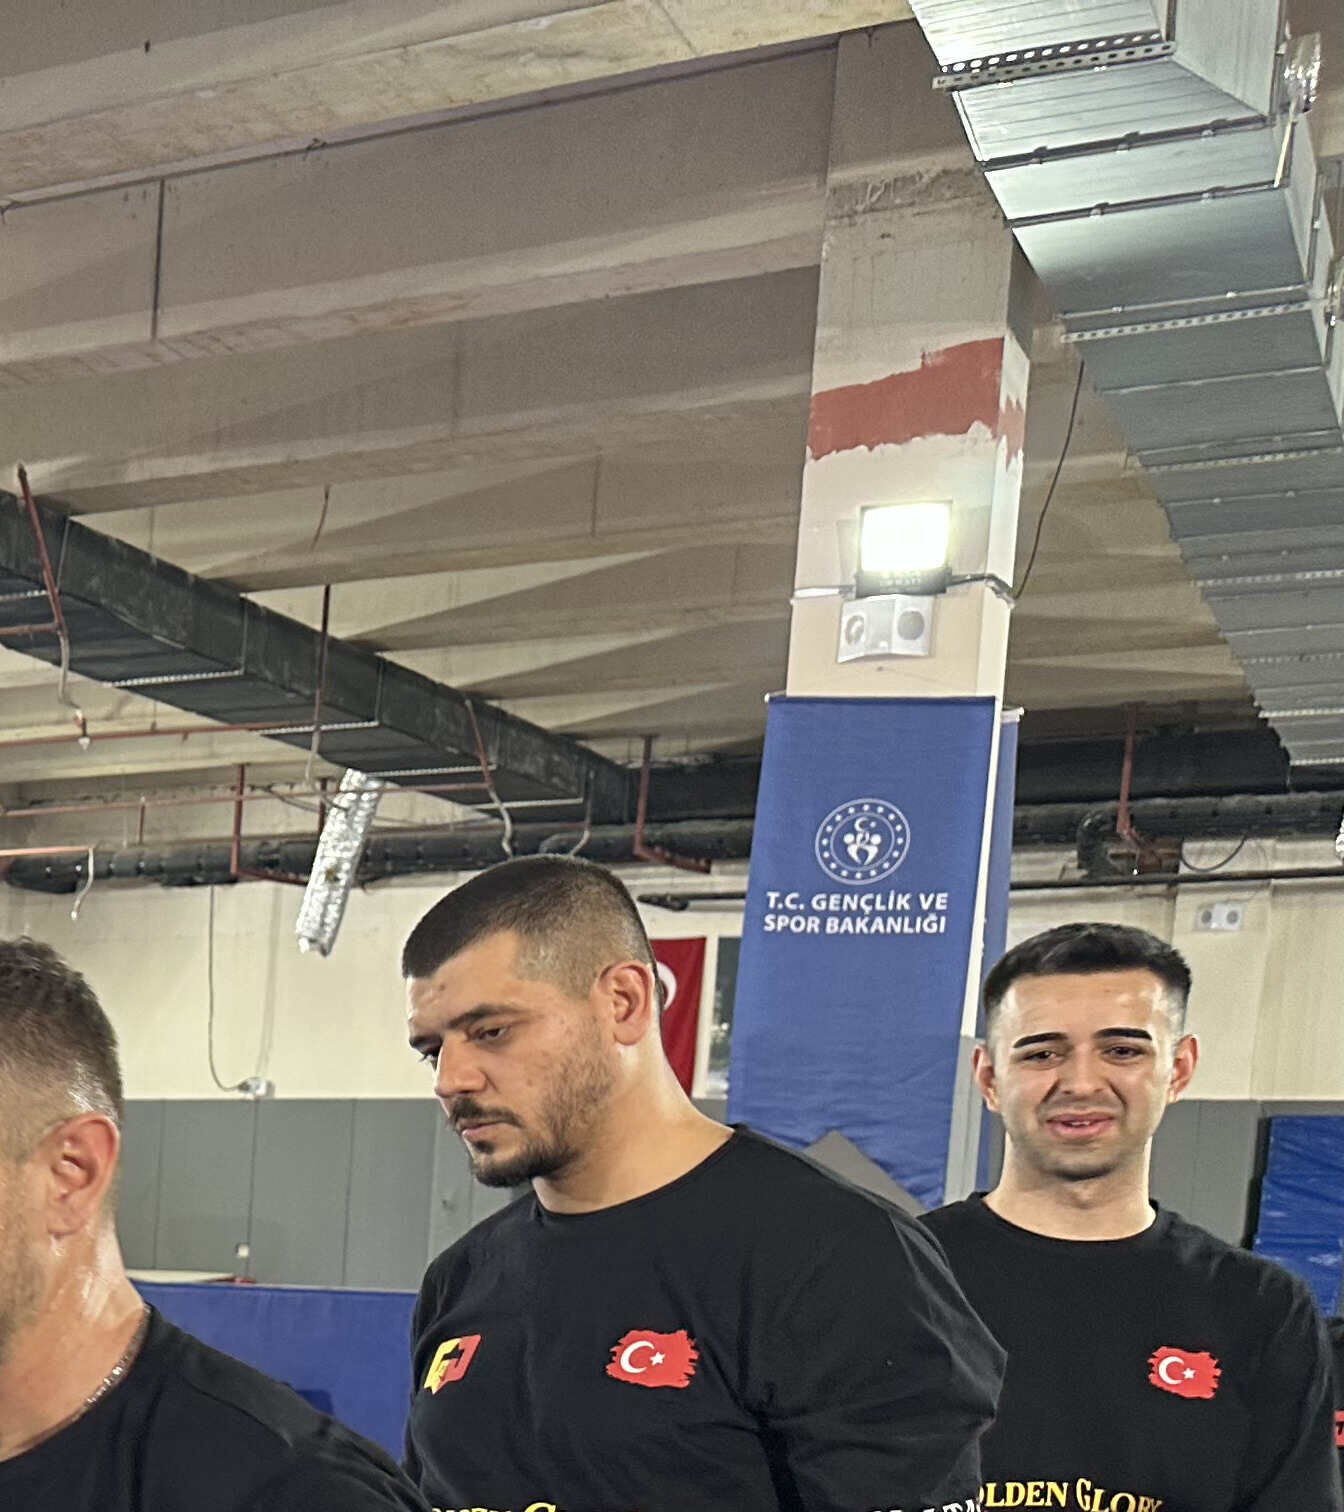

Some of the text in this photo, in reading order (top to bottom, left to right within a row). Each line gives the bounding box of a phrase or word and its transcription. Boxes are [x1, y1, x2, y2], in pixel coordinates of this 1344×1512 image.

[766, 890, 949, 914] T.C. GENÇLİK VE
[764, 913, 946, 934] SPOR BAKANLIĞI
[980, 1481, 1069, 1507] LDEN
